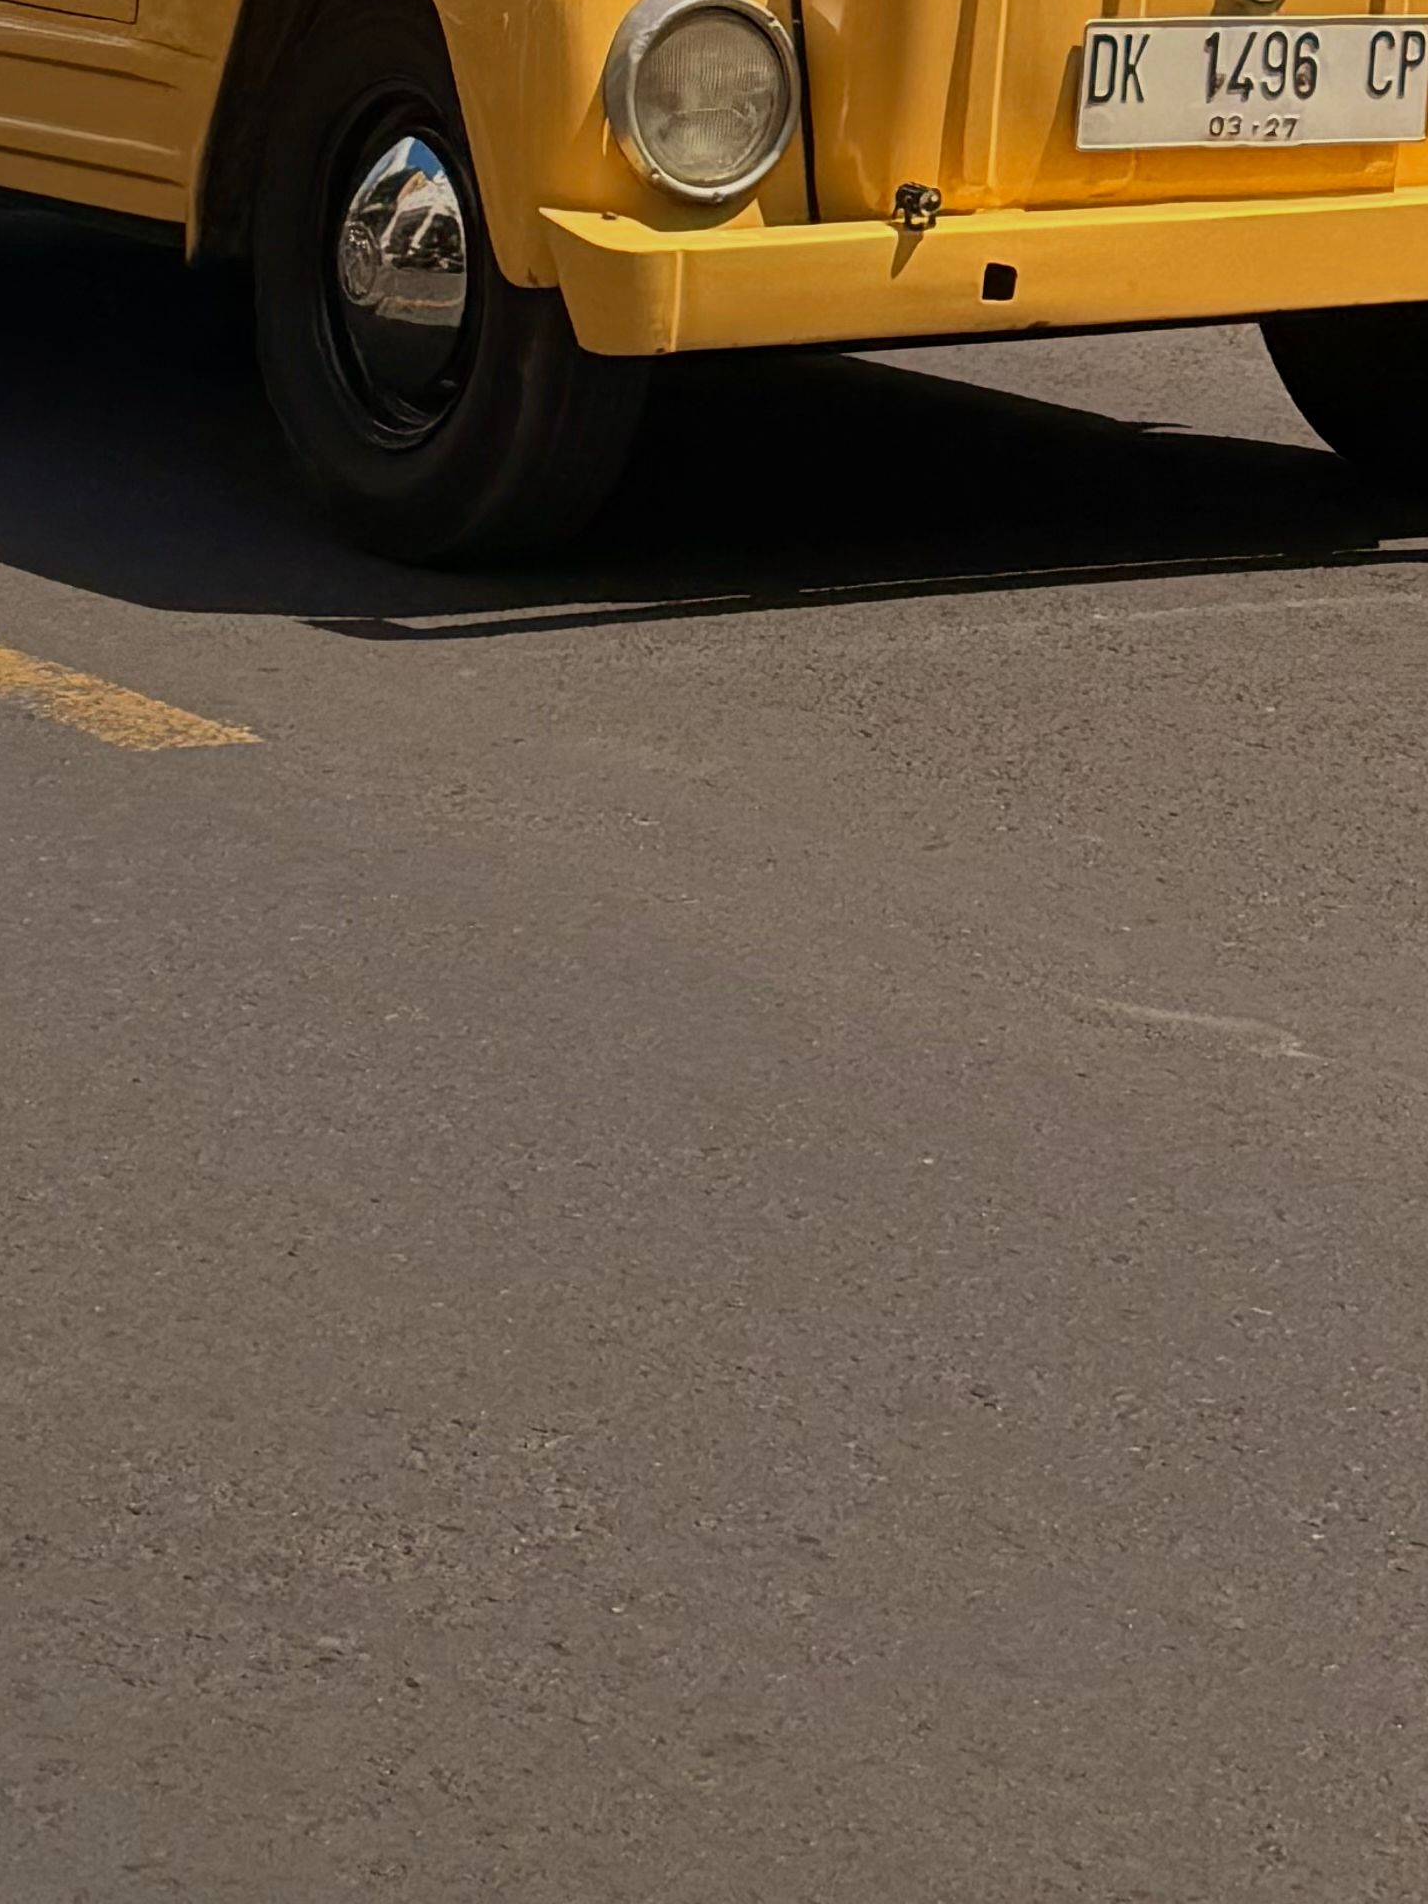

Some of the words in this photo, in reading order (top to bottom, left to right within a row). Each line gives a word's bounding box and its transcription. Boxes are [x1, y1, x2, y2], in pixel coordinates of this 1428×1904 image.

[1086, 33, 1150, 106] DK
[1202, 30, 1321, 103] 1496
[1366, 29, 1427, 99] CP
